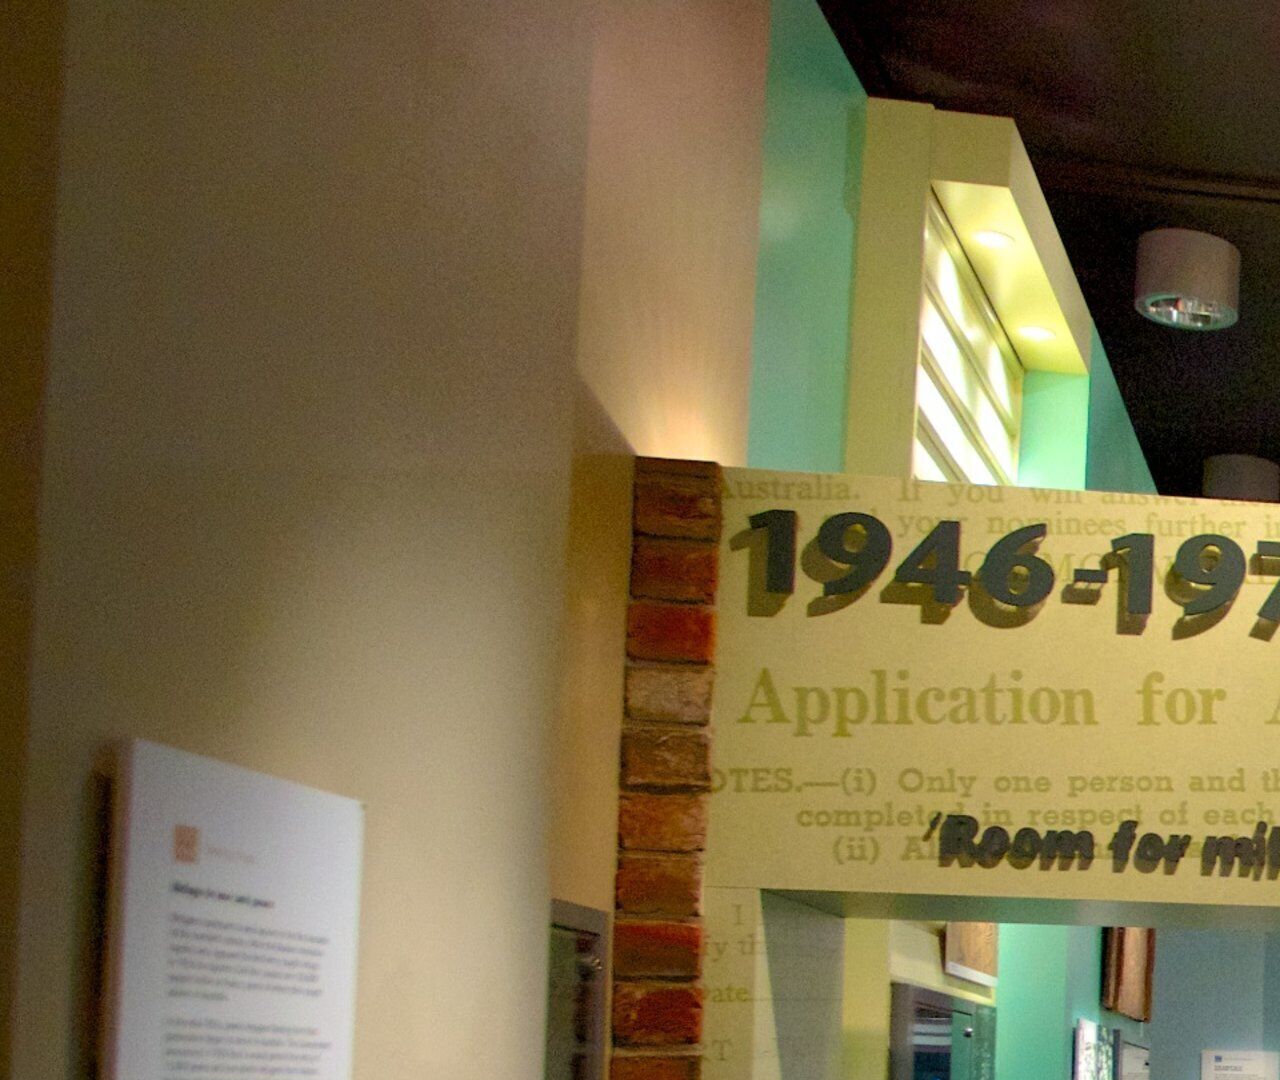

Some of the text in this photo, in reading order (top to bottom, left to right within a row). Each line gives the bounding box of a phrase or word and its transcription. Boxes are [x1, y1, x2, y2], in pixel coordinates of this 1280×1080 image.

[1146, 513, 1247, 541] further
[737, 667, 1098, 738] Application
[1135, 671, 1227, 726] for
[899, 767, 977, 796] Only
[993, 773, 1051, 793] one
[1067, 773, 1173, 797] person
[1188, 769, 1246, 793] and
[983, 804, 1013, 826] in
[1159, 805, 1188, 826] of
[1204, 803, 1274, 826] each
[1110, 820, 1190, 868] for
